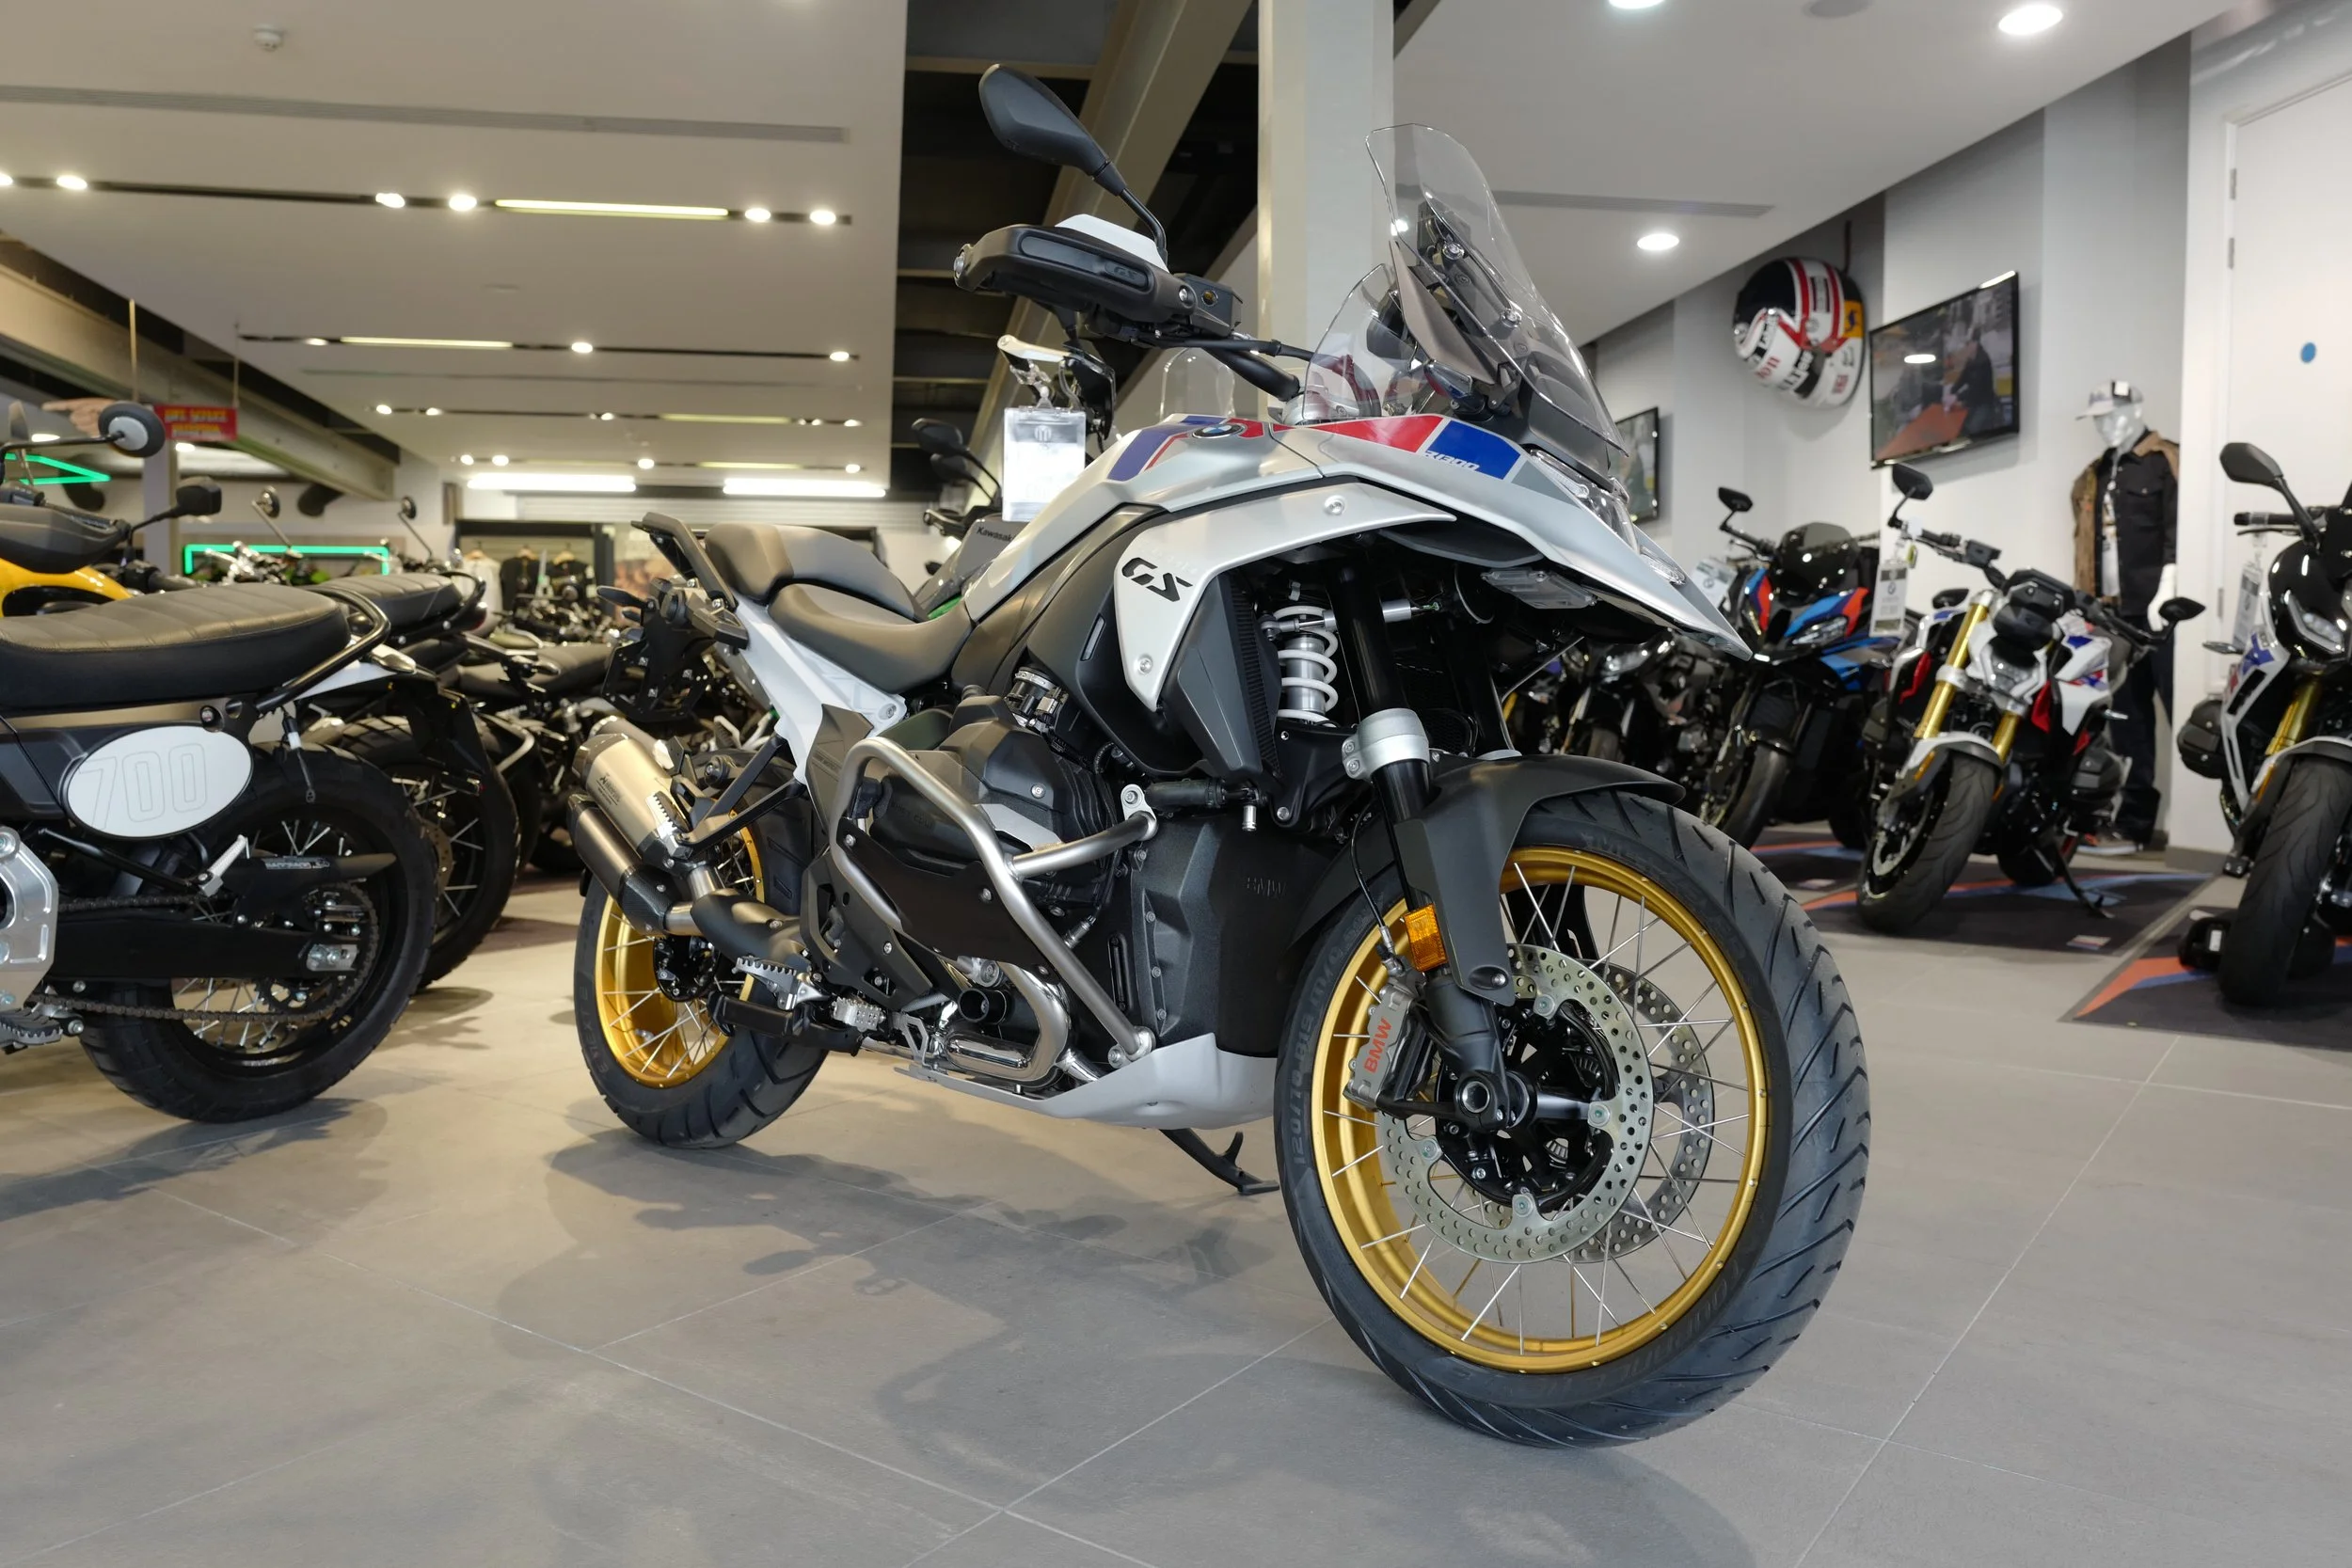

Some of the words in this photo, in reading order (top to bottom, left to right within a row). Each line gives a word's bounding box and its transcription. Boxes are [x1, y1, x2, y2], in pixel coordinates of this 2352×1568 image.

[1424, 450, 1481, 471] R1300
[977, 526, 1014, 543] Kawasak
[1121, 557, 1194, 602] GS
[79, 743, 208, 831] 700
[1247, 877, 1287, 897] BMW
[1364, 1018, 1391, 1072] BMW
